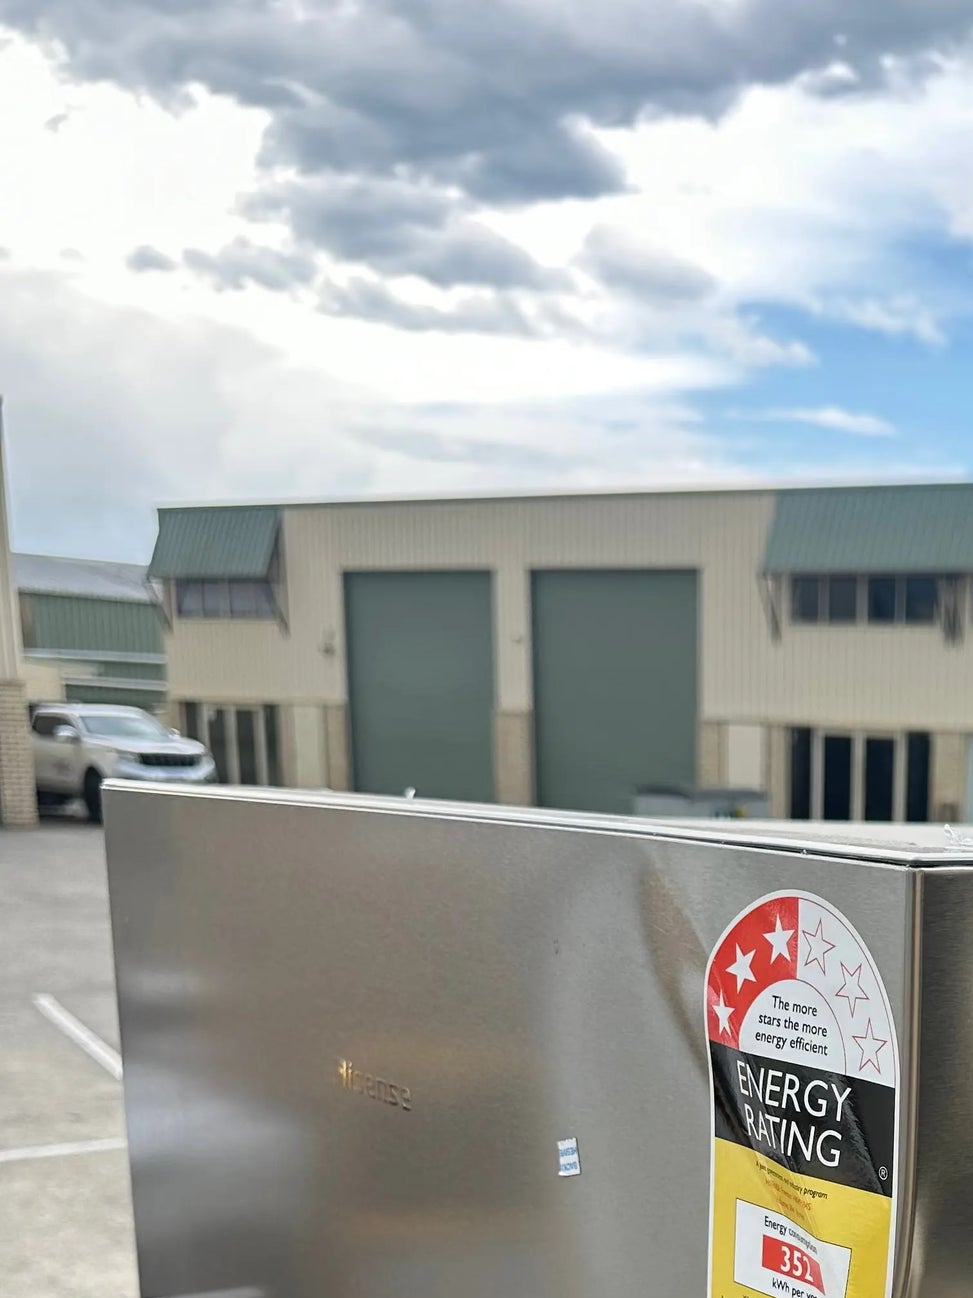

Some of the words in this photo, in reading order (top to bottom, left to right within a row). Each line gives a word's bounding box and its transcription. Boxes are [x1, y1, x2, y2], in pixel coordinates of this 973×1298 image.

[772, 995, 790, 1011] The
[792, 1002, 818, 1017] more
[758, 1013, 781, 1028] stars
[783, 1017, 800, 1031] the
[802, 1023, 828, 1038] more
[755, 1031, 788, 1050] energy
[789, 1038, 828, 1056] efficient
[736, 1059, 852, 1122] ENERGY
[744, 1103, 842, 1168] RATING
[803, 1187, 828, 1199] program
[764, 1215, 787, 1236] Energy
[780, 1245, 814, 1283] 352
[772, 1277, 790, 1293] kWh
